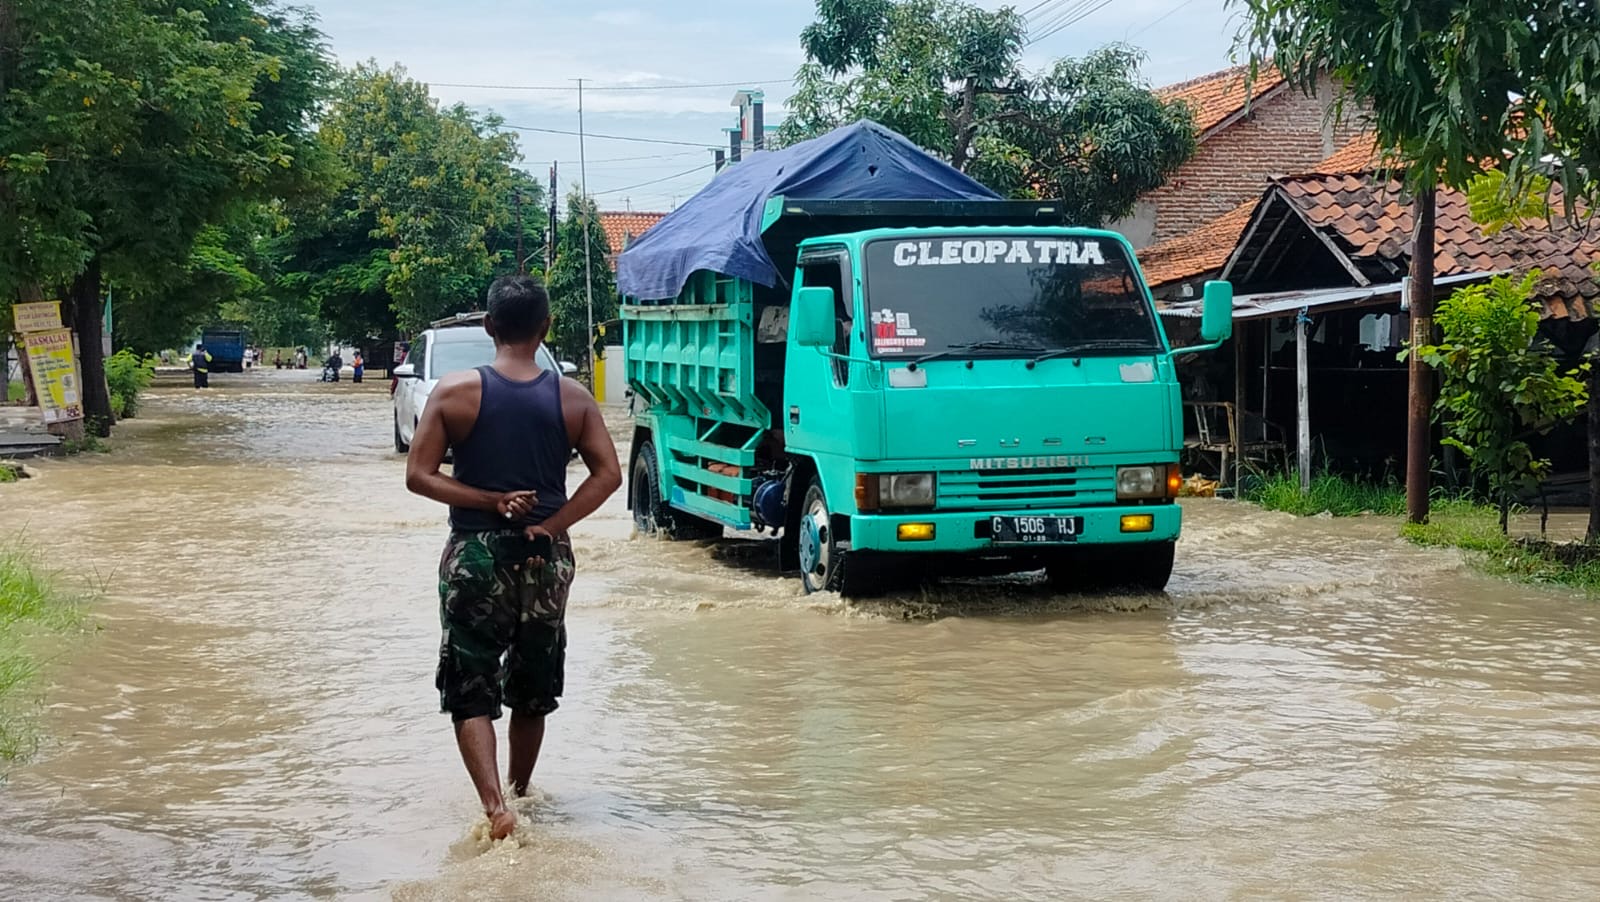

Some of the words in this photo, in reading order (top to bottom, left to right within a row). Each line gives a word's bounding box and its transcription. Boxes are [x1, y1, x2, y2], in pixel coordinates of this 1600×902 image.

[893, 240, 1105, 266] CLEOPATRA
[969, 455, 1090, 470] MITSUBISHI
[993, 516, 1002, 533] G
[1013, 517, 1046, 534] 1506
[1057, 518, 1075, 535] HJ
